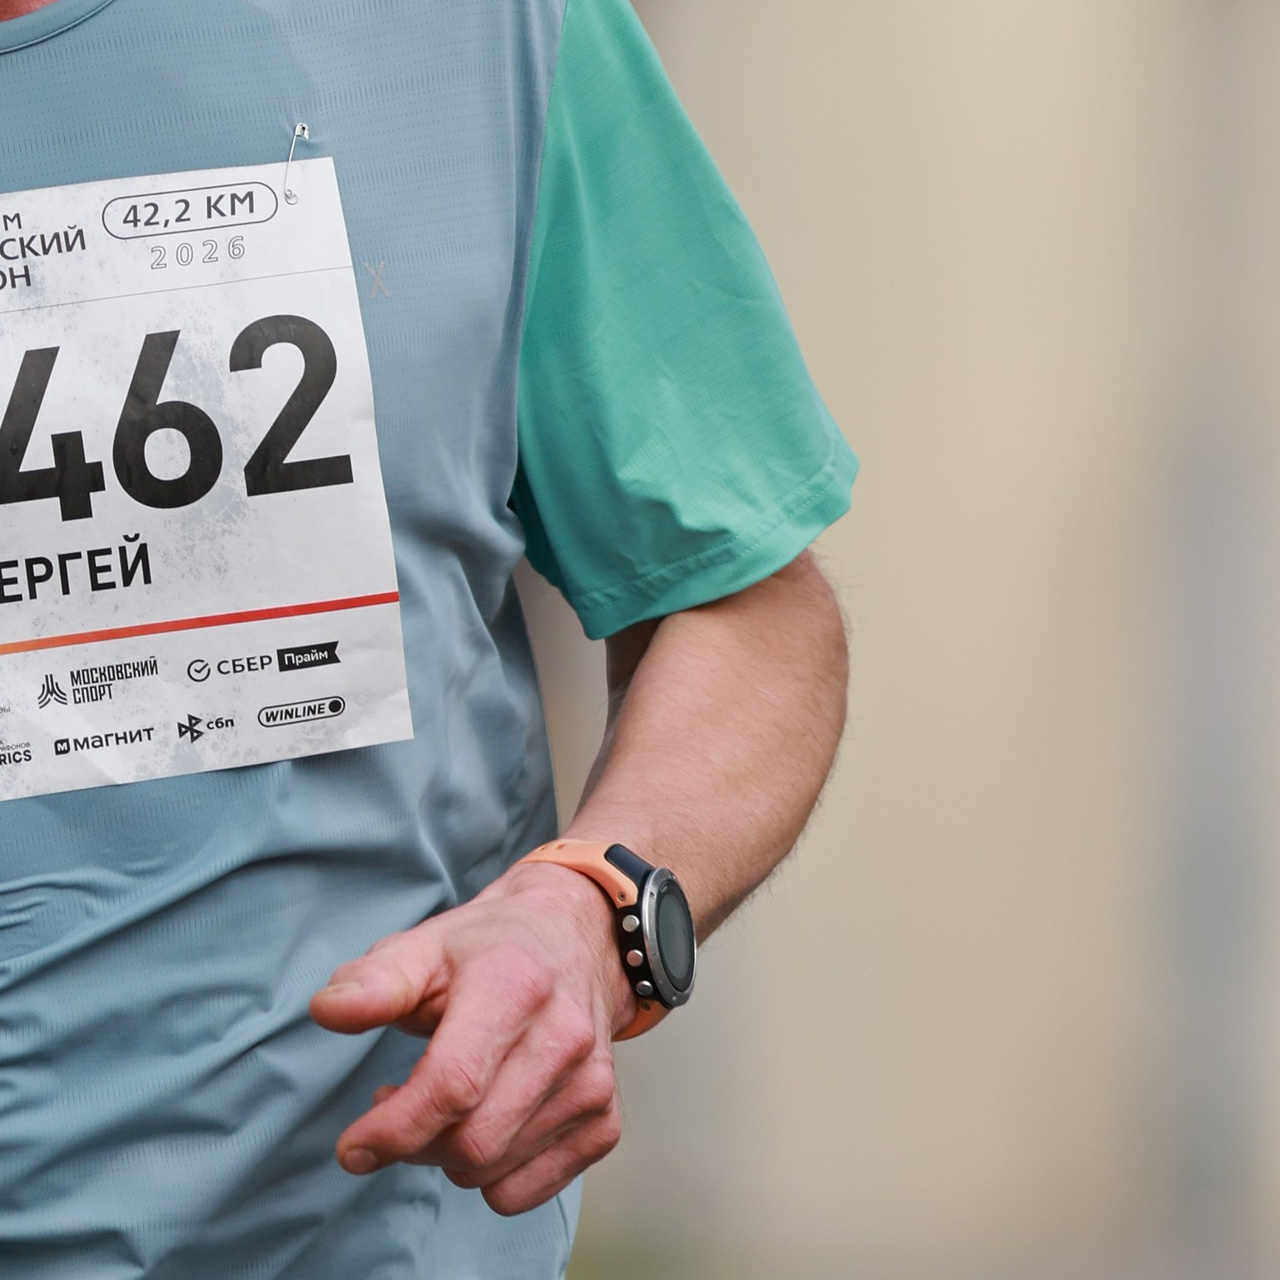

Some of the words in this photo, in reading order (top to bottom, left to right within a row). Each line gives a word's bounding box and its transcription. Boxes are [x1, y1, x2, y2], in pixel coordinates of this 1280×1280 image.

[122, 198, 192, 228] 42,2
[206, 190, 257, 219] КМ
[150, 236, 246, 271] 2026
[71, 656, 159, 686] МОСКОВСКИЙ
[217, 656, 273, 675] СБЕР
[284, 650, 328, 667] Прайм
[73, 683, 114, 704] СПОРТ
[264, 702, 326, 723] WINLINE
